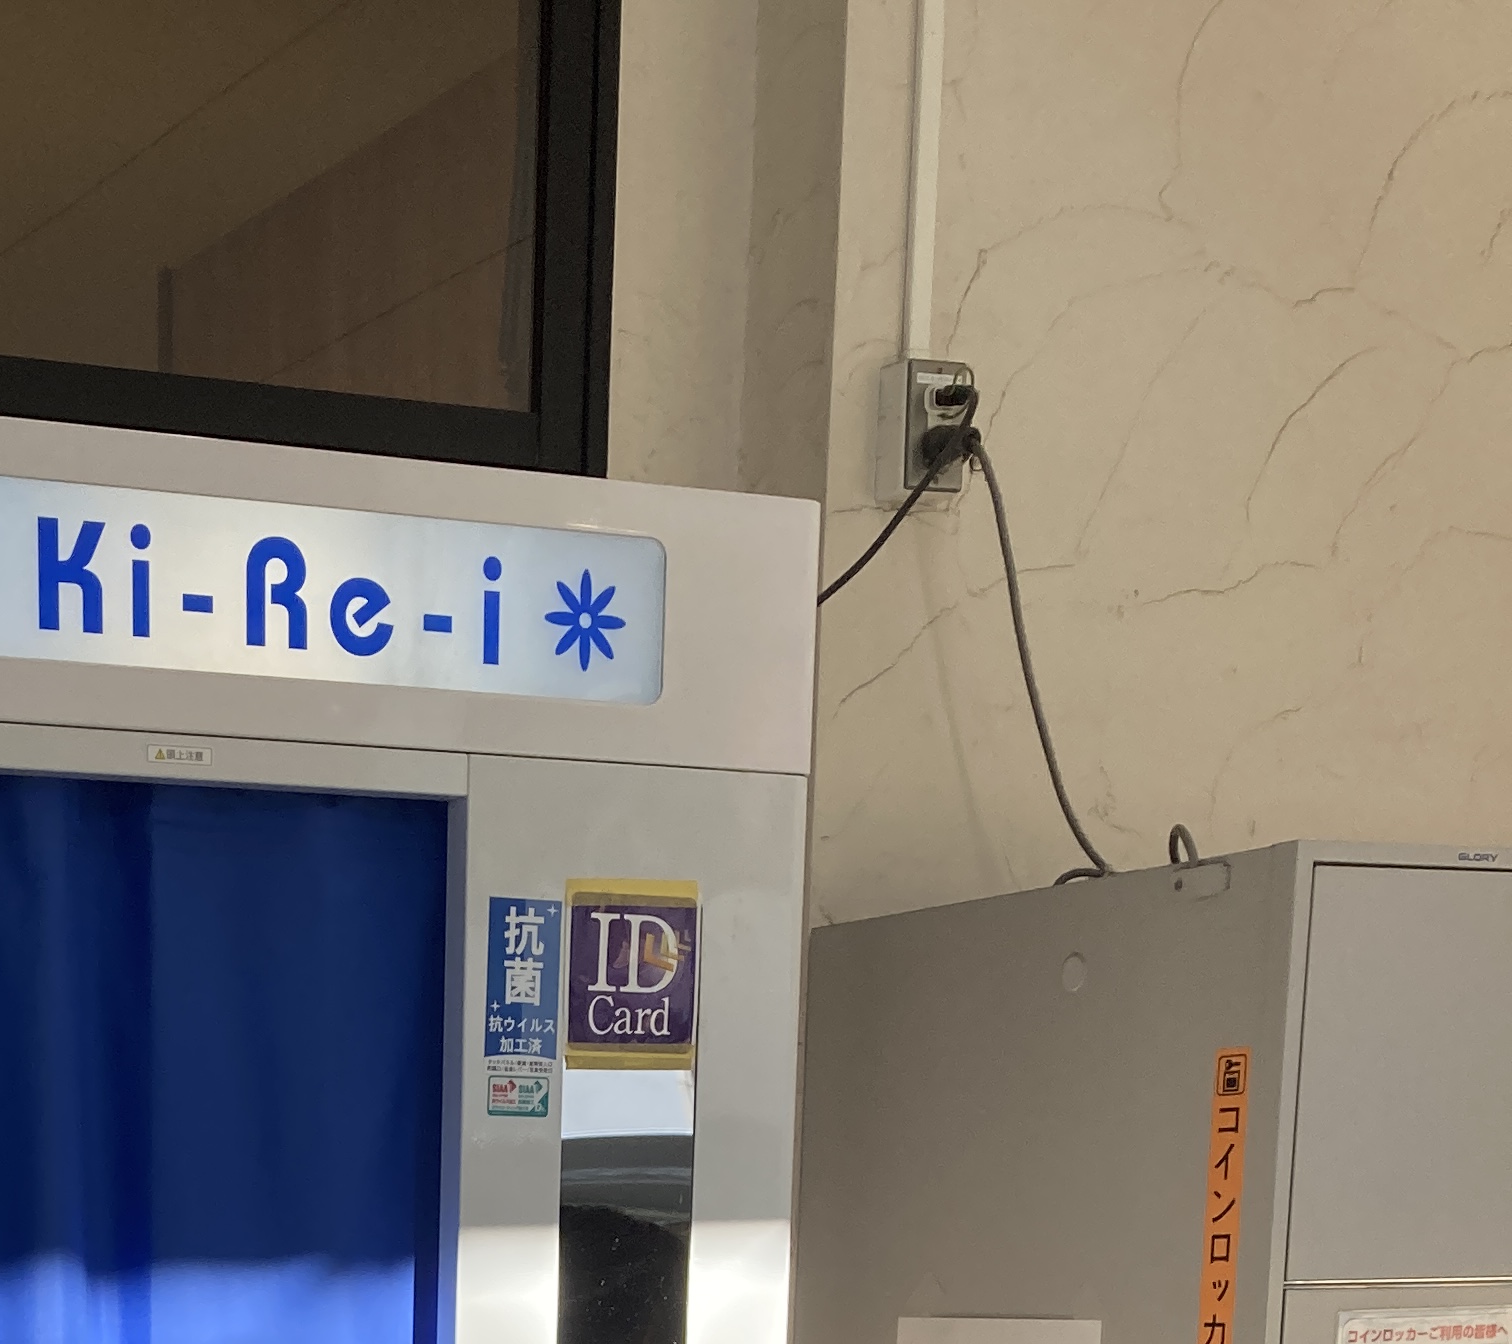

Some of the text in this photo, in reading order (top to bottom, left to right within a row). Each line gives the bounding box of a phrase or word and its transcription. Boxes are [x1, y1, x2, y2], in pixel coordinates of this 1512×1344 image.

[37, 516, 502, 667] Ki-Re-i
[1458, 852, 1499, 862] GLORY
[504, 905, 545, 1007] 抗菌
[588, 912, 679, 994] ID
[488, 1015, 555, 1034] 抗ウイルス
[588, 995, 671, 1036] Card
[499, 1037, 543, 1055] 加工済
[1346, 1323, 1509, 1344] コインロッカーご利用の皆様へ
